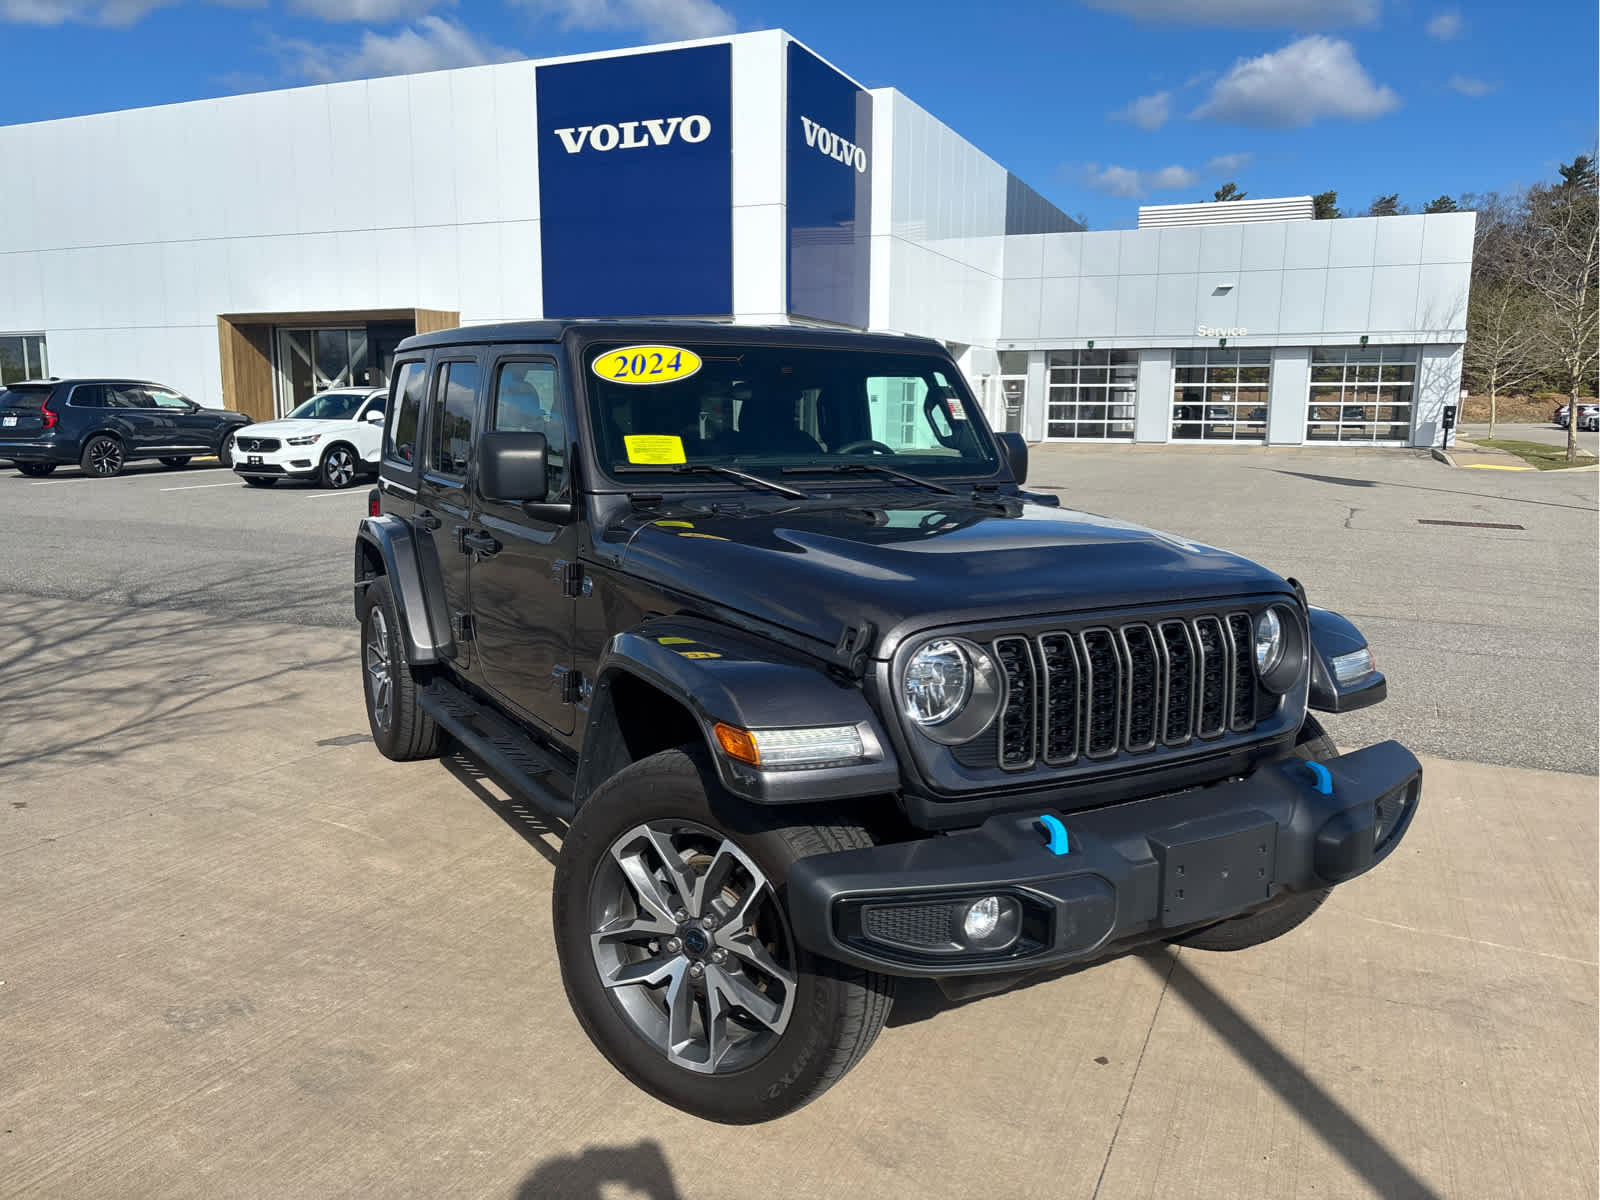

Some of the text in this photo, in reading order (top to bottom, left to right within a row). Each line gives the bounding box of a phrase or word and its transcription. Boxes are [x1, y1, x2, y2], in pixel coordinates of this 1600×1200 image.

[554, 114, 711, 153] VOLVO
[801, 115, 866, 173] VOLVO
[1198, 325, 1248, 337] Service
[614, 352, 682, 378] 2024
